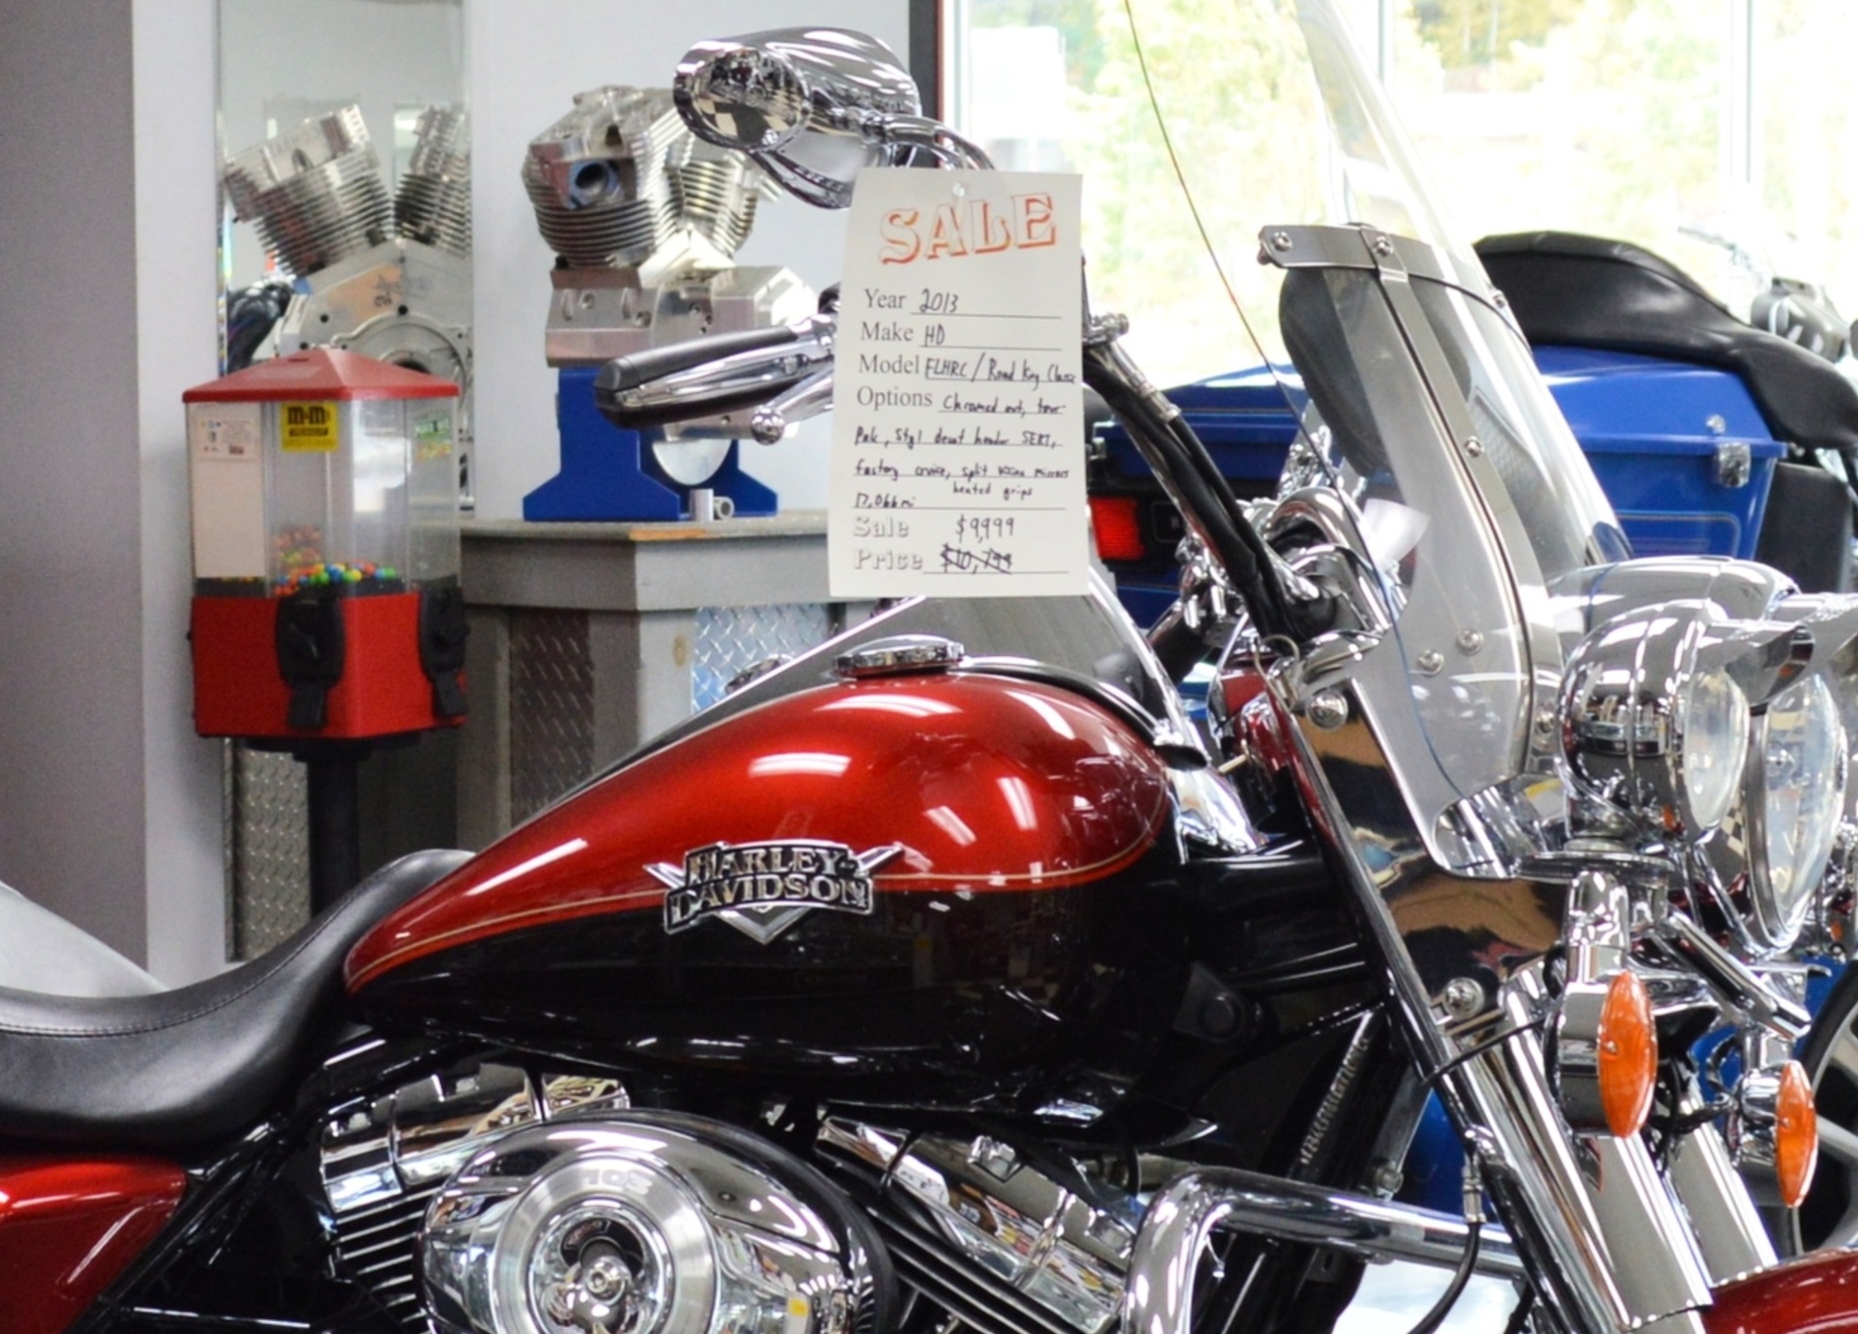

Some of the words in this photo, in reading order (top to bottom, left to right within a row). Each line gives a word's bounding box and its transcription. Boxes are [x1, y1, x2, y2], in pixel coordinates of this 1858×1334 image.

[878, 192, 1058, 265] SALE
[864, 288, 907, 309] Year
[919, 288, 959, 314] 2013
[860, 321, 915, 343] Make
[924, 323, 946, 347] HD
[858, 353, 920, 375] Model
[987, 357, 1016, 382] Road
[856, 385, 934, 412] Options
[943, 392, 999, 414] Chromed
[855, 458, 899, 482] factory
[961, 462, 988, 483] split
[952, 480, 992, 496] heated
[1002, 485, 1033, 501] grips
[853, 516, 910, 538] Sale
[955, 513, 1015, 544] $9,999
[853, 549, 924, 571] Price
[670, 873, 869, 925] DAVIDSON
[582, 1168, 654, 1195] 103
